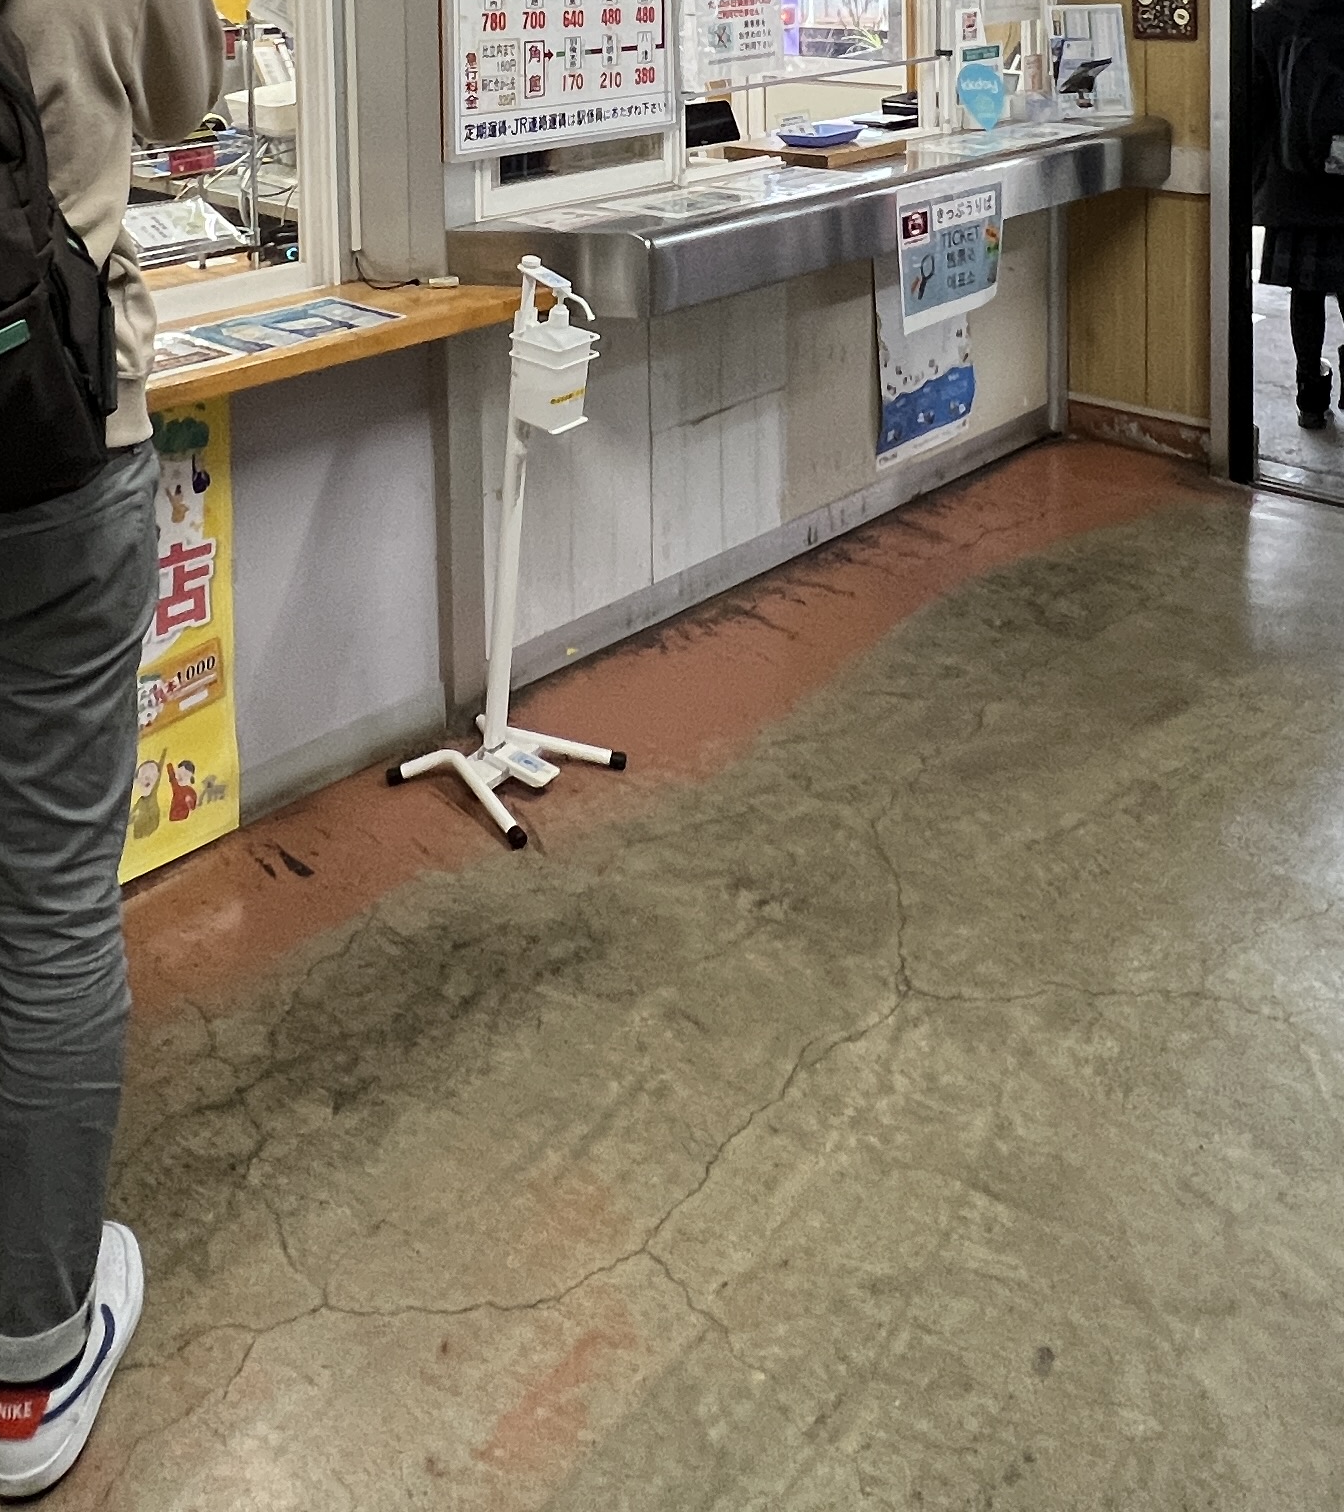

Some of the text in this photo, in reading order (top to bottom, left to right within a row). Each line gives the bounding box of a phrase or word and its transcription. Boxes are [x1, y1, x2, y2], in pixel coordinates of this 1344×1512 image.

[482, 12, 506, 31] 780
[523, 11, 546, 29] 700
[563, 10, 584, 28] 640
[601, 8, 622, 25] 480
[636, 7, 655, 23] 480
[563, 74, 584, 91] 170
[600, 72, 622, 88] 210
[635, 67, 655, 85] 380
